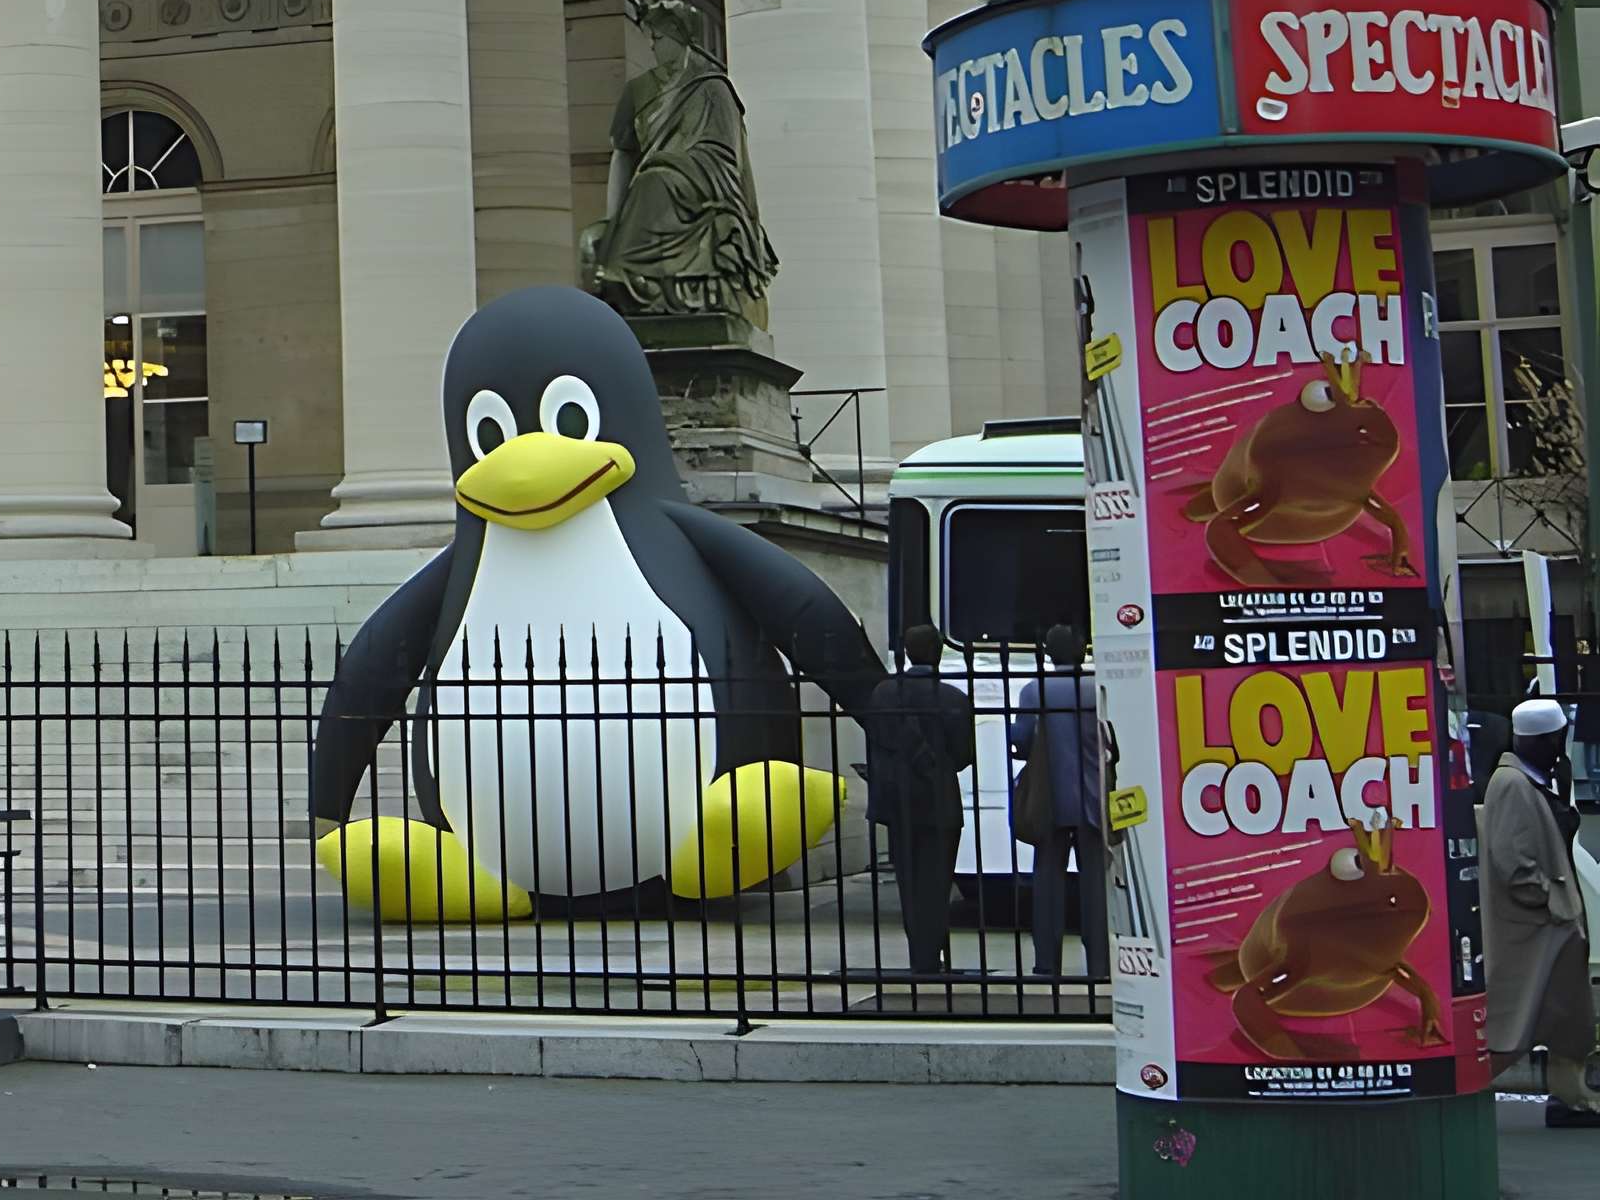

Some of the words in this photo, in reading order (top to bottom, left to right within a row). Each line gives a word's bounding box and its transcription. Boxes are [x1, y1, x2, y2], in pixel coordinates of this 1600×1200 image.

[935, 18, 1194, 154] ECTACLES
[1260, 9, 1556, 116] SPECTACLE
[1196, 169, 1353, 203] SPLENDID
[1146, 208, 1400, 313] LOVE
[1154, 292, 1405, 372] COACH
[1223, 628, 1387, 664] SPLENDID
[1175, 667, 1432, 776] LOVE
[1181, 754, 1436, 837] COACH
